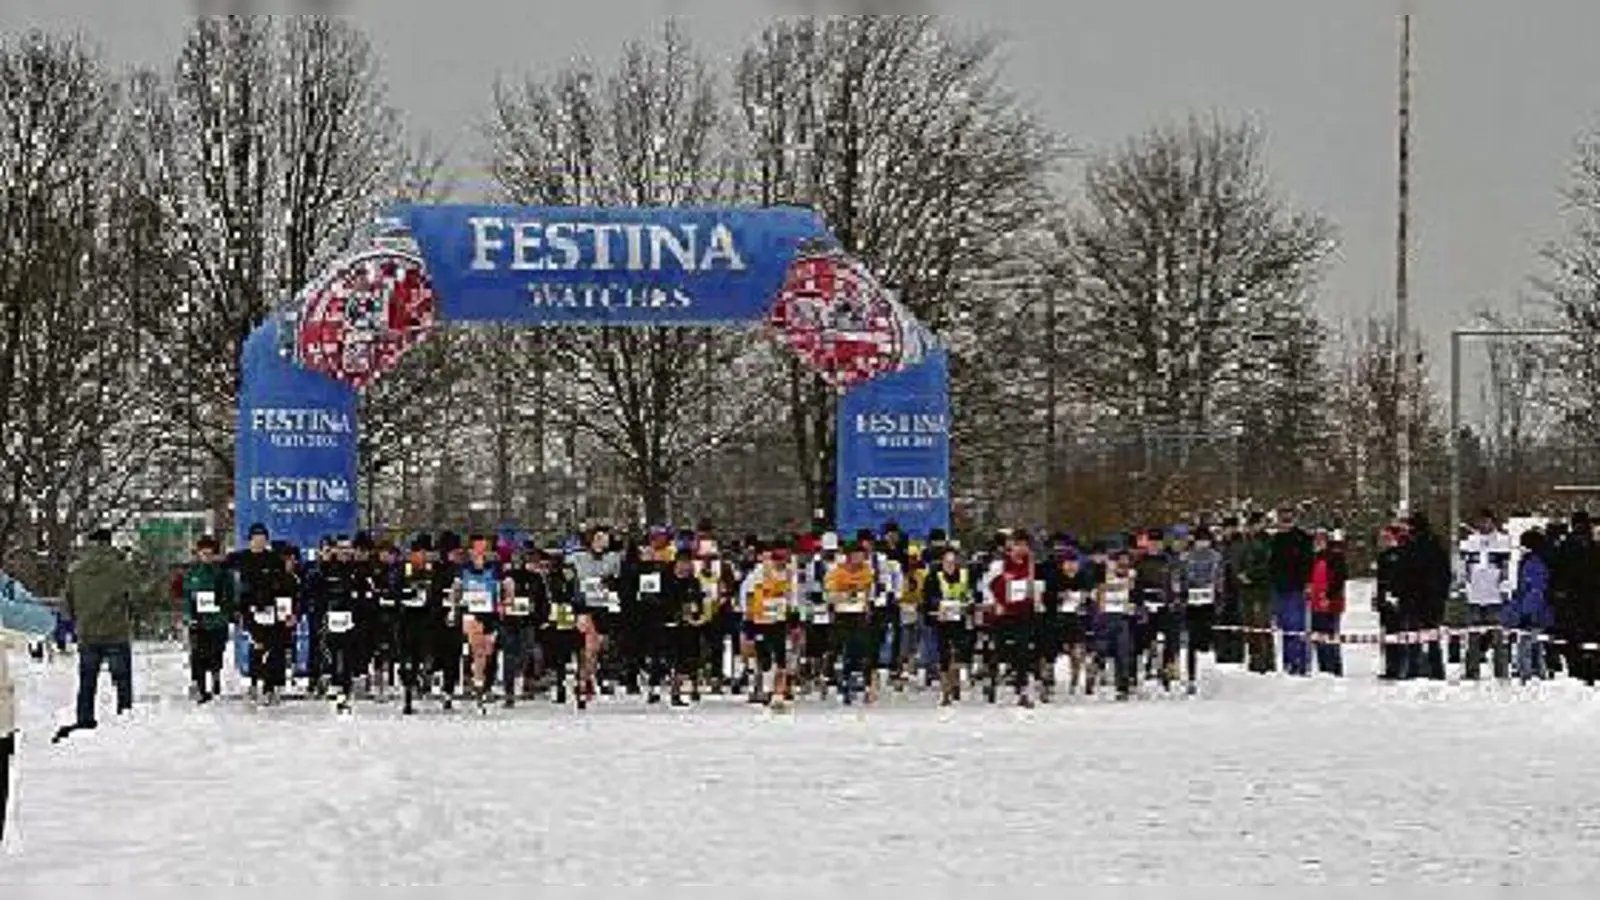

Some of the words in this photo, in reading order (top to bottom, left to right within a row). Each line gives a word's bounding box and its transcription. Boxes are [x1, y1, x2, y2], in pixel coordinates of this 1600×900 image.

[467, 216, 747, 271] FESTINA
[250, 408, 352, 433] FESTINA
[250, 476, 350, 502] FESTINA
